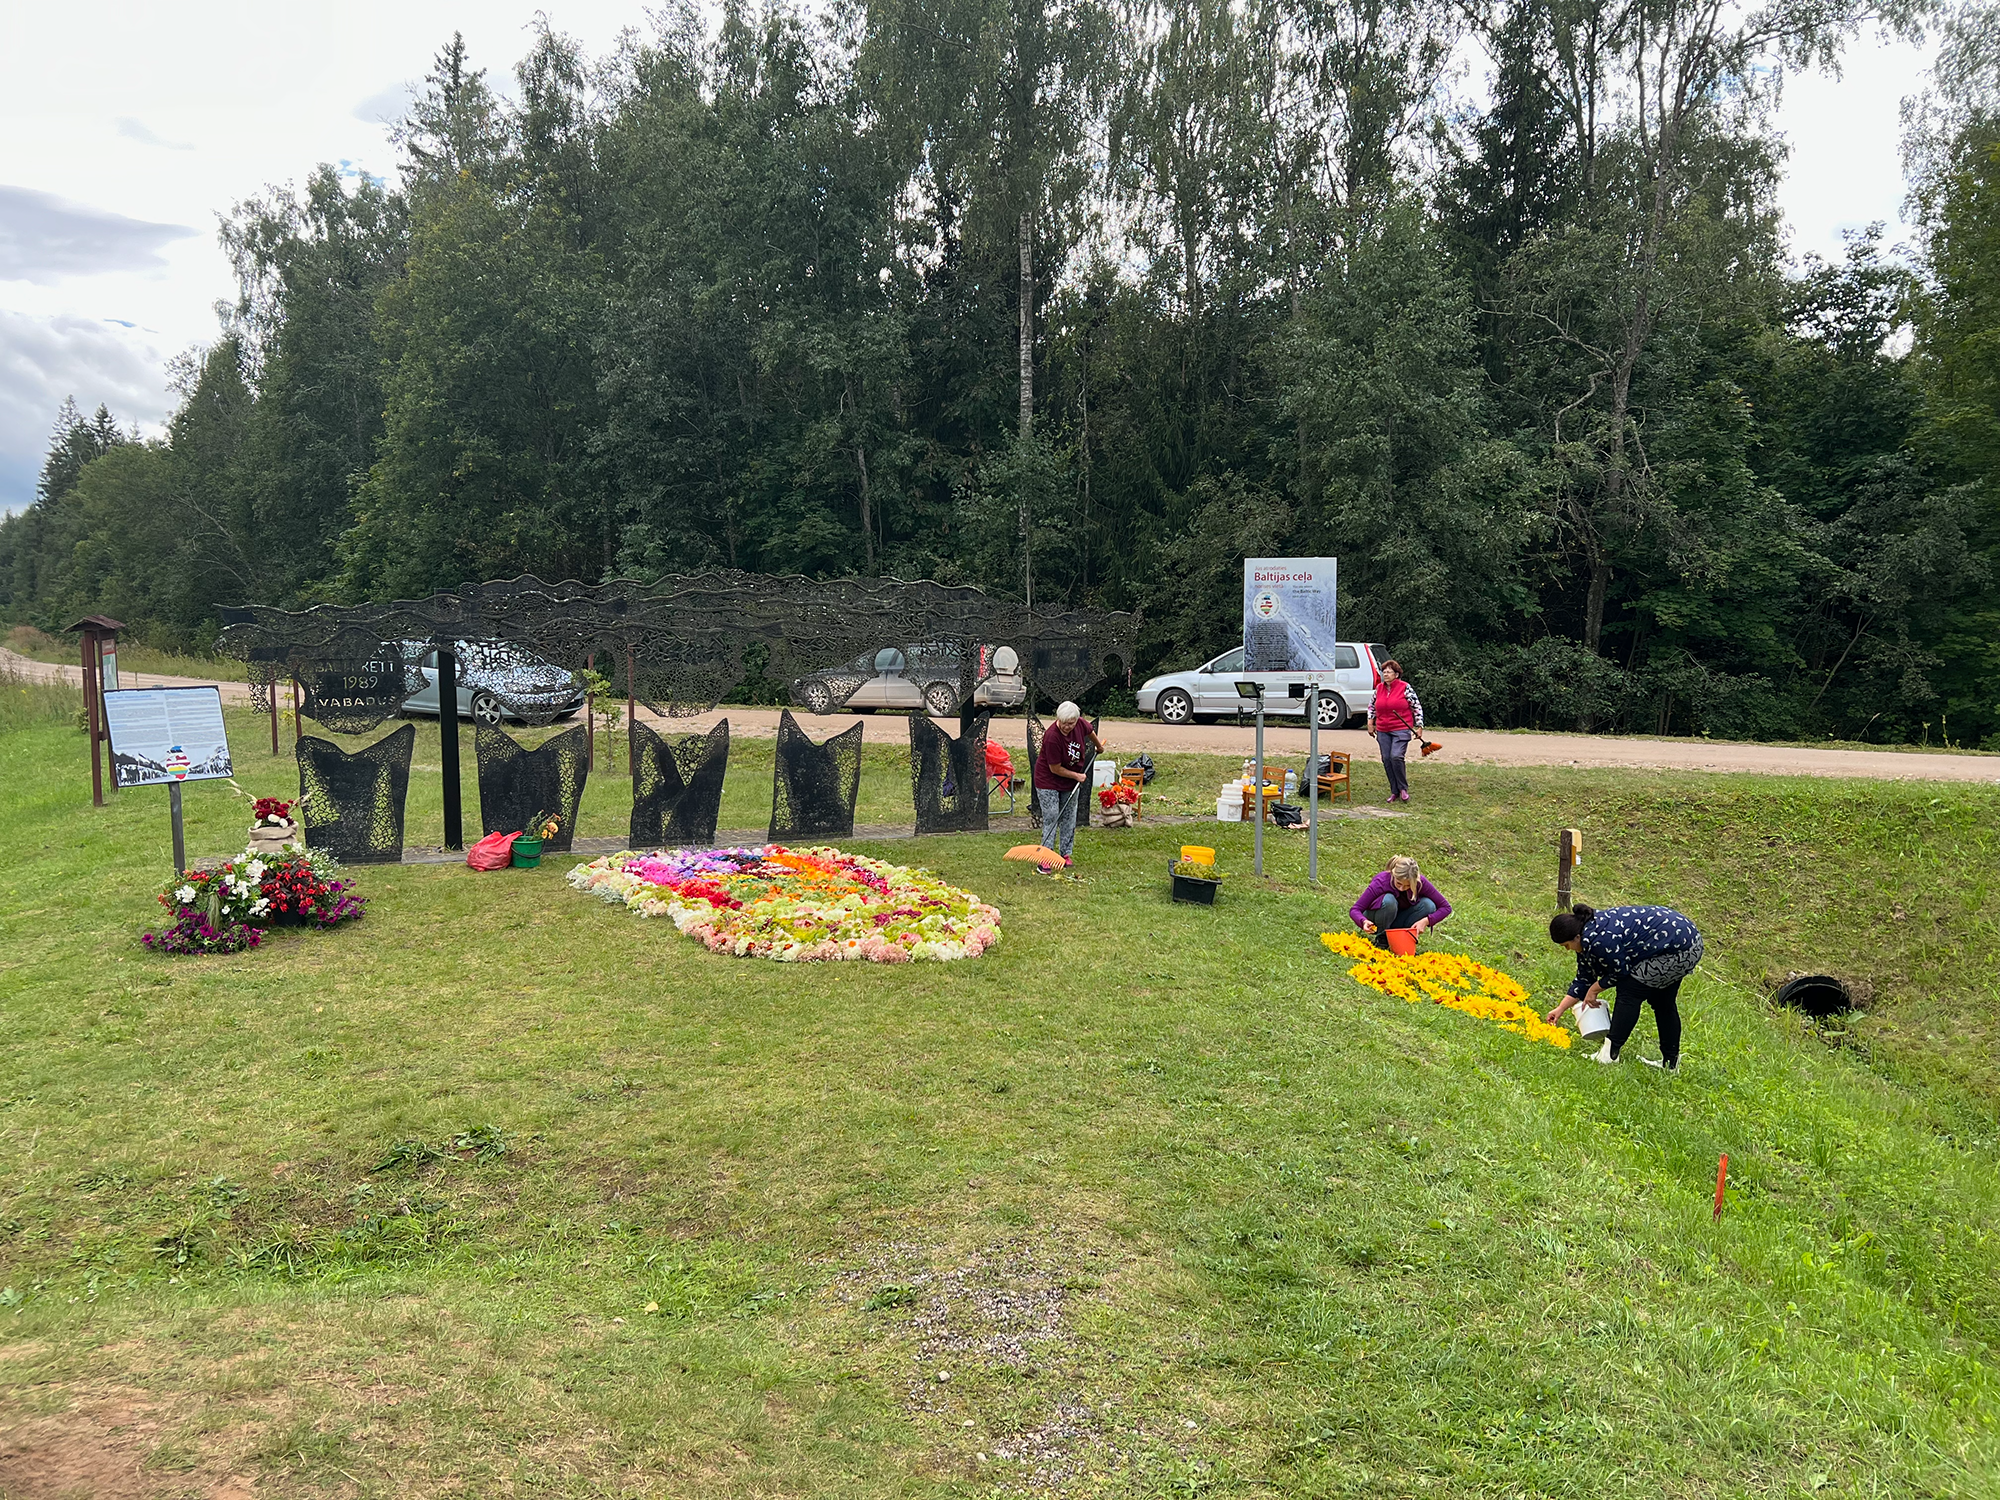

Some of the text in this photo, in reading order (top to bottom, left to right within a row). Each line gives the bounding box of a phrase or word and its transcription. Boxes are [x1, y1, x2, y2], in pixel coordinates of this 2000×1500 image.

[1254, 572, 1313, 583] Baltijas ceļa
[361, 661, 395, 673] KETT
[343, 676, 378, 689] 1989
[318, 695, 397, 707] VABADUS
